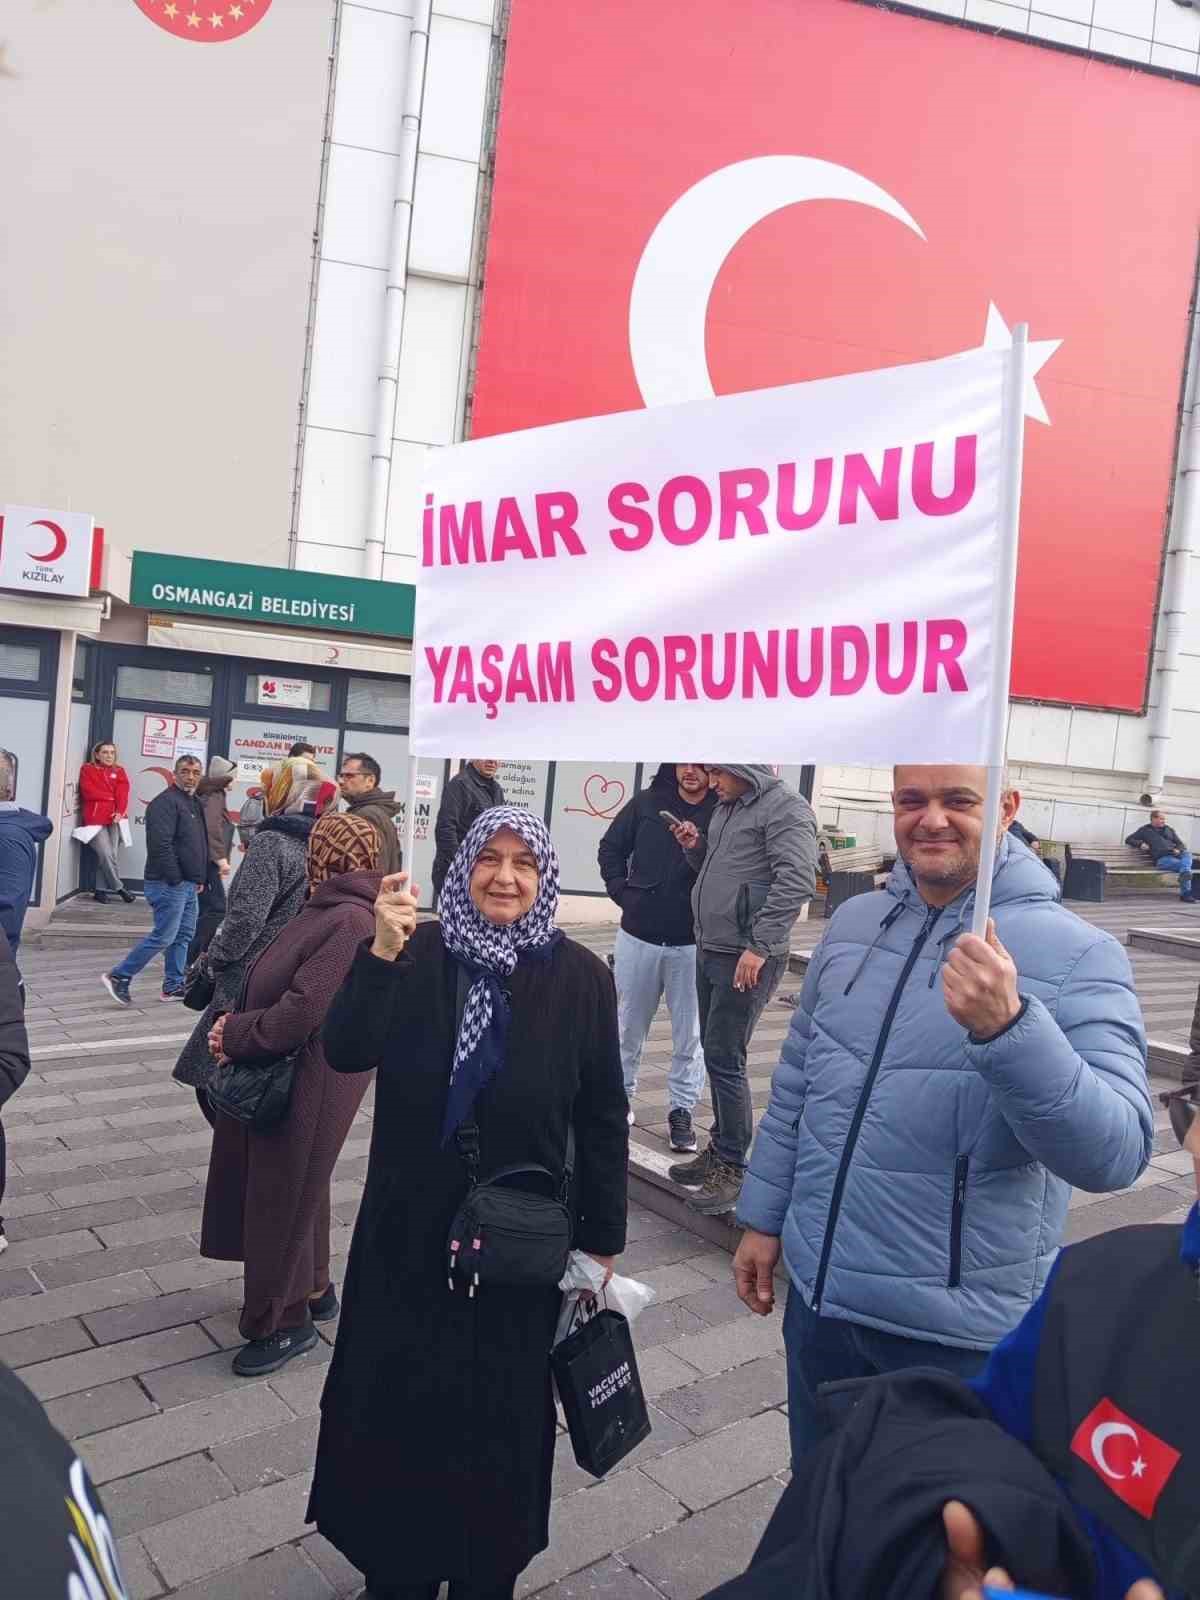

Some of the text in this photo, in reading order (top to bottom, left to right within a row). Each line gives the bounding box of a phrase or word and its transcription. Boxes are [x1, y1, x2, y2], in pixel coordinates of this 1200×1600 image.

[422, 434, 978, 568] İMAR SORUNU
[22, 569, 65, 584] KIZILAY
[151, 583, 356, 623] OSMANGAZİ BELEDİYESİ
[424, 617, 969, 720] YAŞAM SORUNUDUR
[234, 738, 283, 750] CANDAN
[588, 1361, 630, 1398] VACUUM
[591, 1371, 632, 1409] FLASK SET
